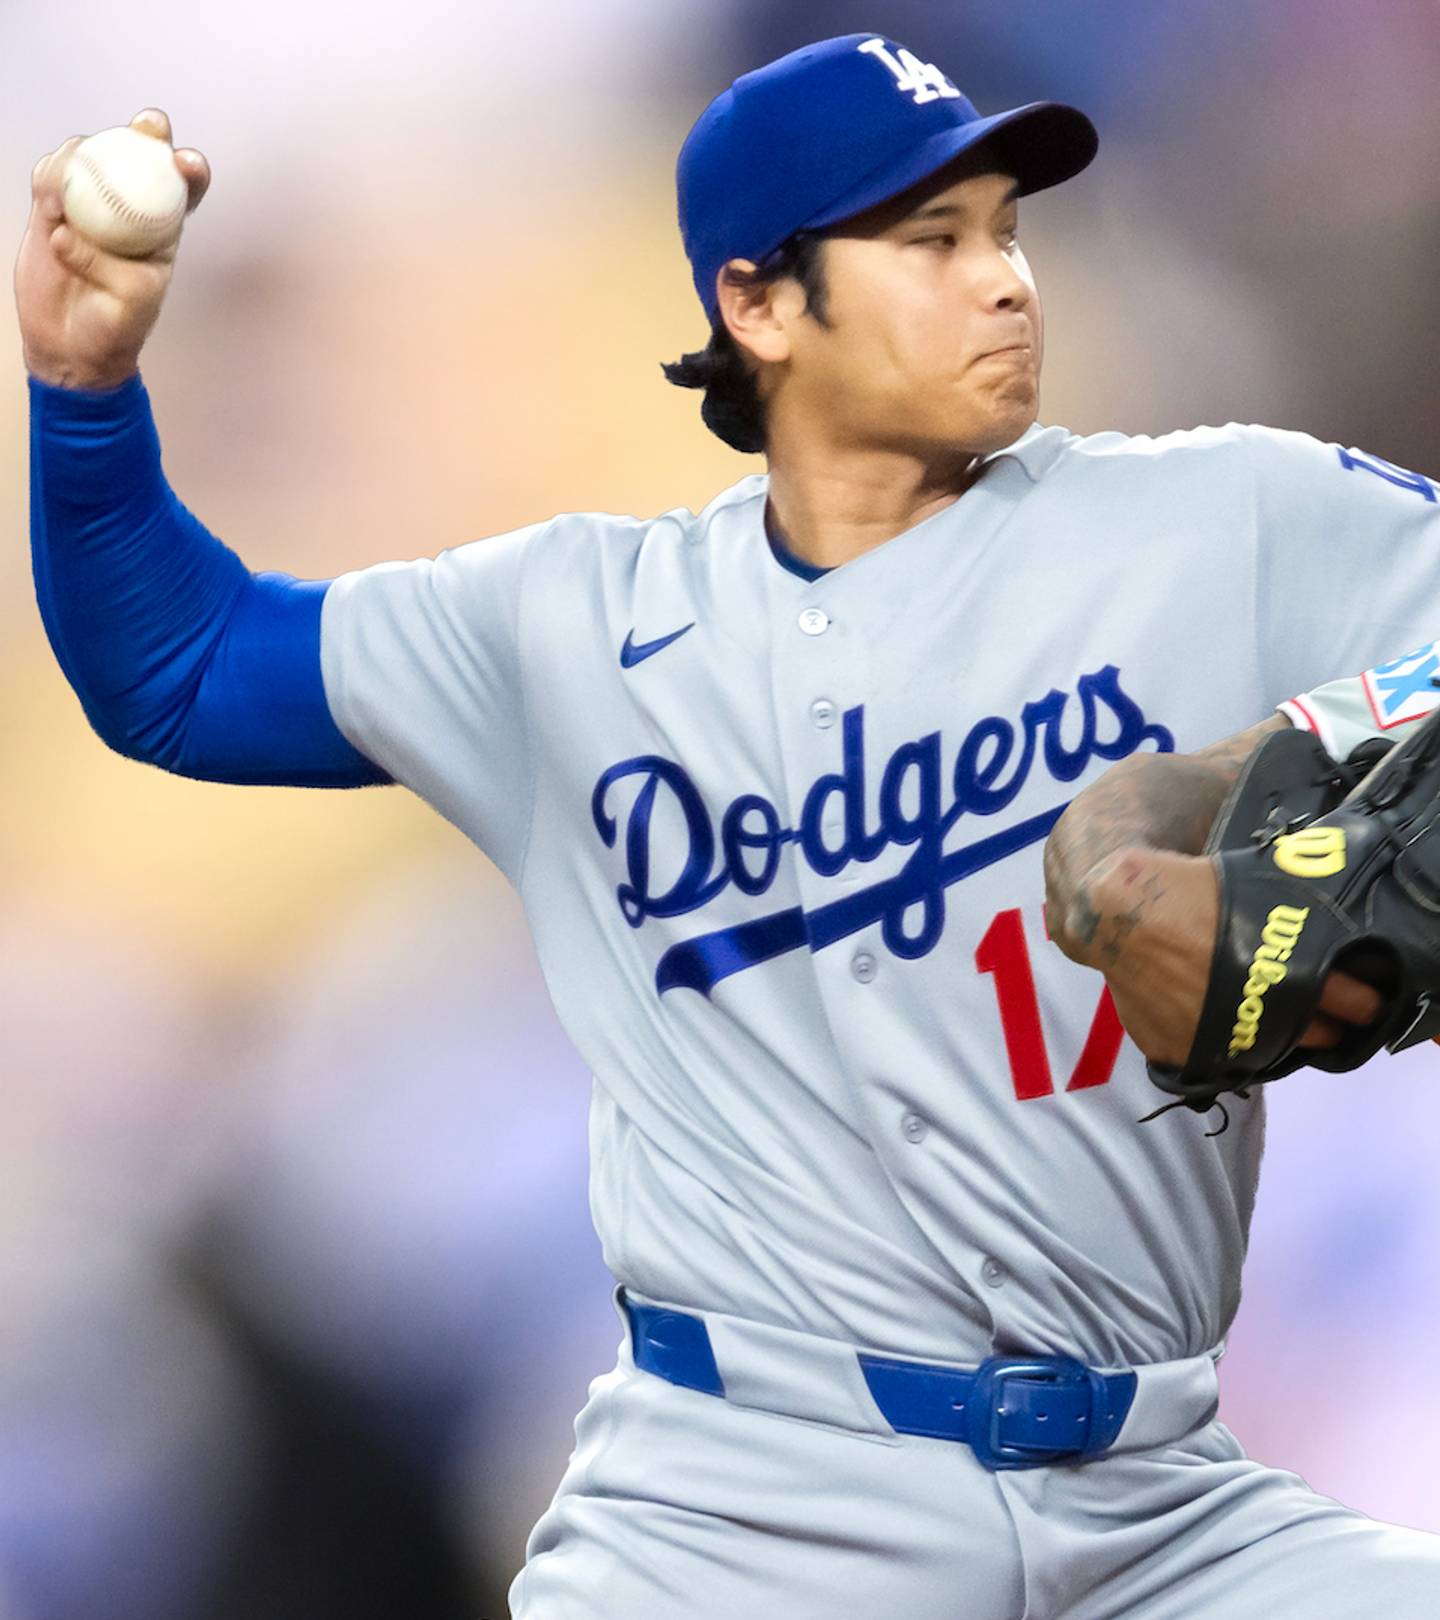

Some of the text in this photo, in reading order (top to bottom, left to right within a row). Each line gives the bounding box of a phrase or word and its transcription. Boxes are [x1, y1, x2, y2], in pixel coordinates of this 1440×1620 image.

[857, 38, 960, 104] LA
[591, 664, 1176, 960] Dodgers
[1228, 904, 1310, 1059] Wilson
